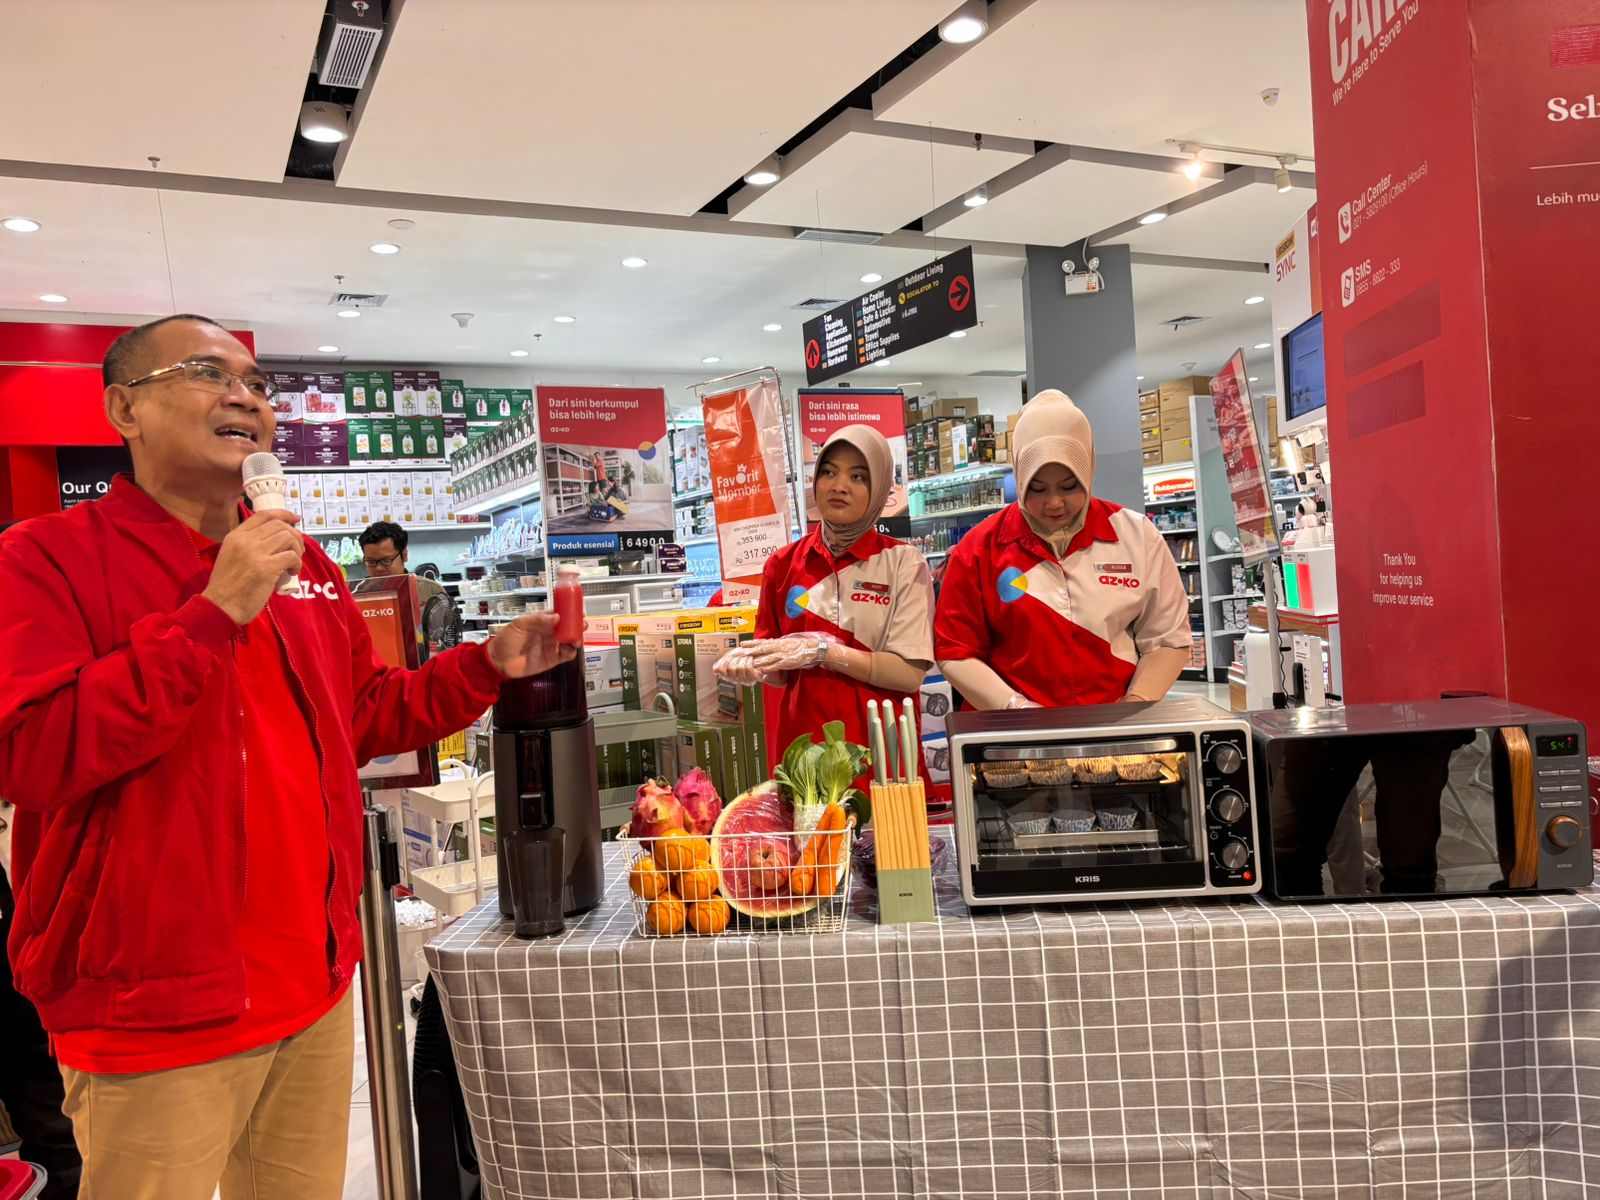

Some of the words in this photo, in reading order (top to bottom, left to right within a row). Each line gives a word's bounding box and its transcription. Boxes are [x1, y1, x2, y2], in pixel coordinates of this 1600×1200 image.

[1329, 0, 1408, 84] CA
[1352, 58, 1369, 84] Here
[1370, 48, 1378, 64] to
[1379, 20, 1402, 53] Serve
[1402, 0, 1419, 24] You
[1547, 94, 1600, 122] Sel
[1352, 192, 1366, 215] Call
[1367, 173, 1392, 203] Center
[1537, 192, 1574, 206] Lebih
[1577, 192, 1600, 203] mu
[1276, 250, 1297, 282] SYNC
[1355, 259, 1371, 282] SMS
[905, 270, 926, 287] Outdoor
[926, 263, 944, 278] Living
[863, 303, 876, 315] Home
[876, 296, 892, 310] Living
[824, 314, 833, 324] Fan
[864, 314, 875, 325] Safe
[880, 304, 897, 318] Locker
[825, 319, 844, 333] Cleaning
[826, 325, 849, 341] Appliances
[865, 316, 892, 334] Automotive
[865, 328, 880, 343] Travel
[865, 340, 879, 353] Office
[880, 332, 900, 347] Supplies
[828, 353, 849, 369] Hardware
[866, 347, 887, 362] Lighting
[548, 398, 569, 408] Dari
[570, 398, 588, 408] sini
[589, 398, 640, 410] berkumpul
[808, 400, 825, 410] Dari
[826, 400, 841, 410] sini
[842, 401, 859, 410] rasa
[549, 409, 570, 420] bisa
[571, 410, 595, 420] lebih
[596, 410, 617, 422] lega
[808, 411, 826, 421] bisa
[827, 410, 847, 421] lebih
[848, 411, 881, 421] istimewa
[62, 482, 92, 494] Our
[718, 484, 760, 502] Member
[552, 541, 581, 550] Produk
[583, 539, 615, 550] esensial
[1383, 553, 1403, 566] Thank
[1403, 553, 1416, 566] You
[1380, 572, 1388, 585] for
[1389, 572, 1413, 589] helping
[1414, 575, 1424, 586] us
[1372, 591, 1397, 606] improve
[1397, 594, 1409, 605] our
[1410, 593, 1434, 607] service
[1075, 875, 1100, 884] KRIS
